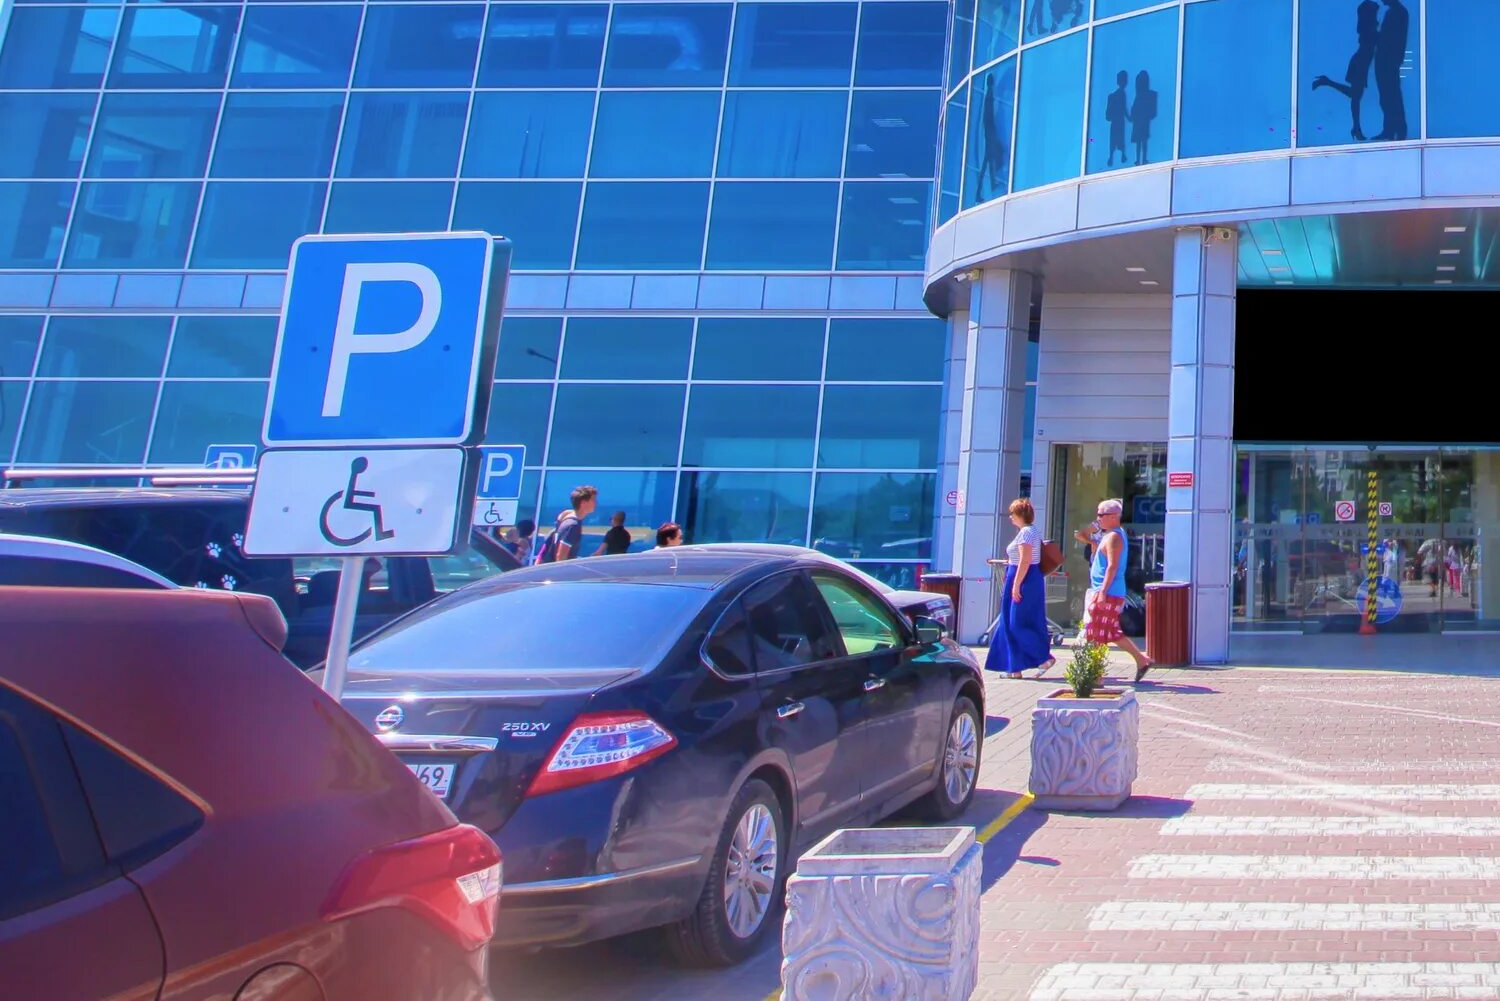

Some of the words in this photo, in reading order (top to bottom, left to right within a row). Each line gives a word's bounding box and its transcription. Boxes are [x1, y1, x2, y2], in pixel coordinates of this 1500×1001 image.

[321, 262, 442, 417] P
[482, 452, 514, 493] P
[502, 722, 529, 732] 250
[529, 722, 551, 732] XV
